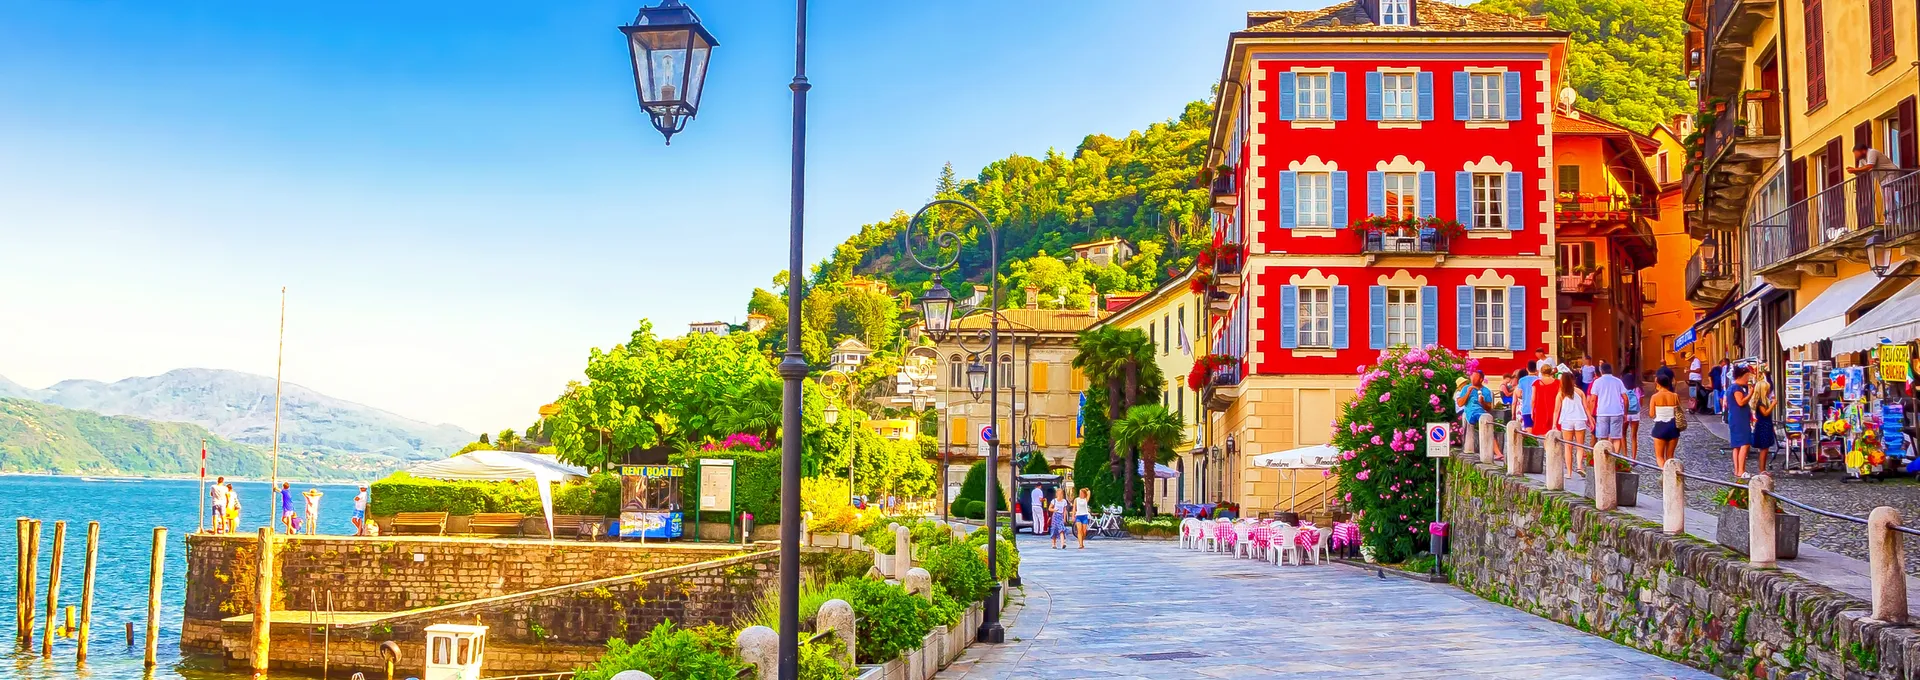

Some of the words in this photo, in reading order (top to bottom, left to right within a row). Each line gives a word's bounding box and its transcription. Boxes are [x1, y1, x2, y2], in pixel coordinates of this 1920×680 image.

[1882, 347, 1908, 362] DEUTSCHE
[622, 466, 645, 476] RENT
[647, 466, 671, 477] BOAT
